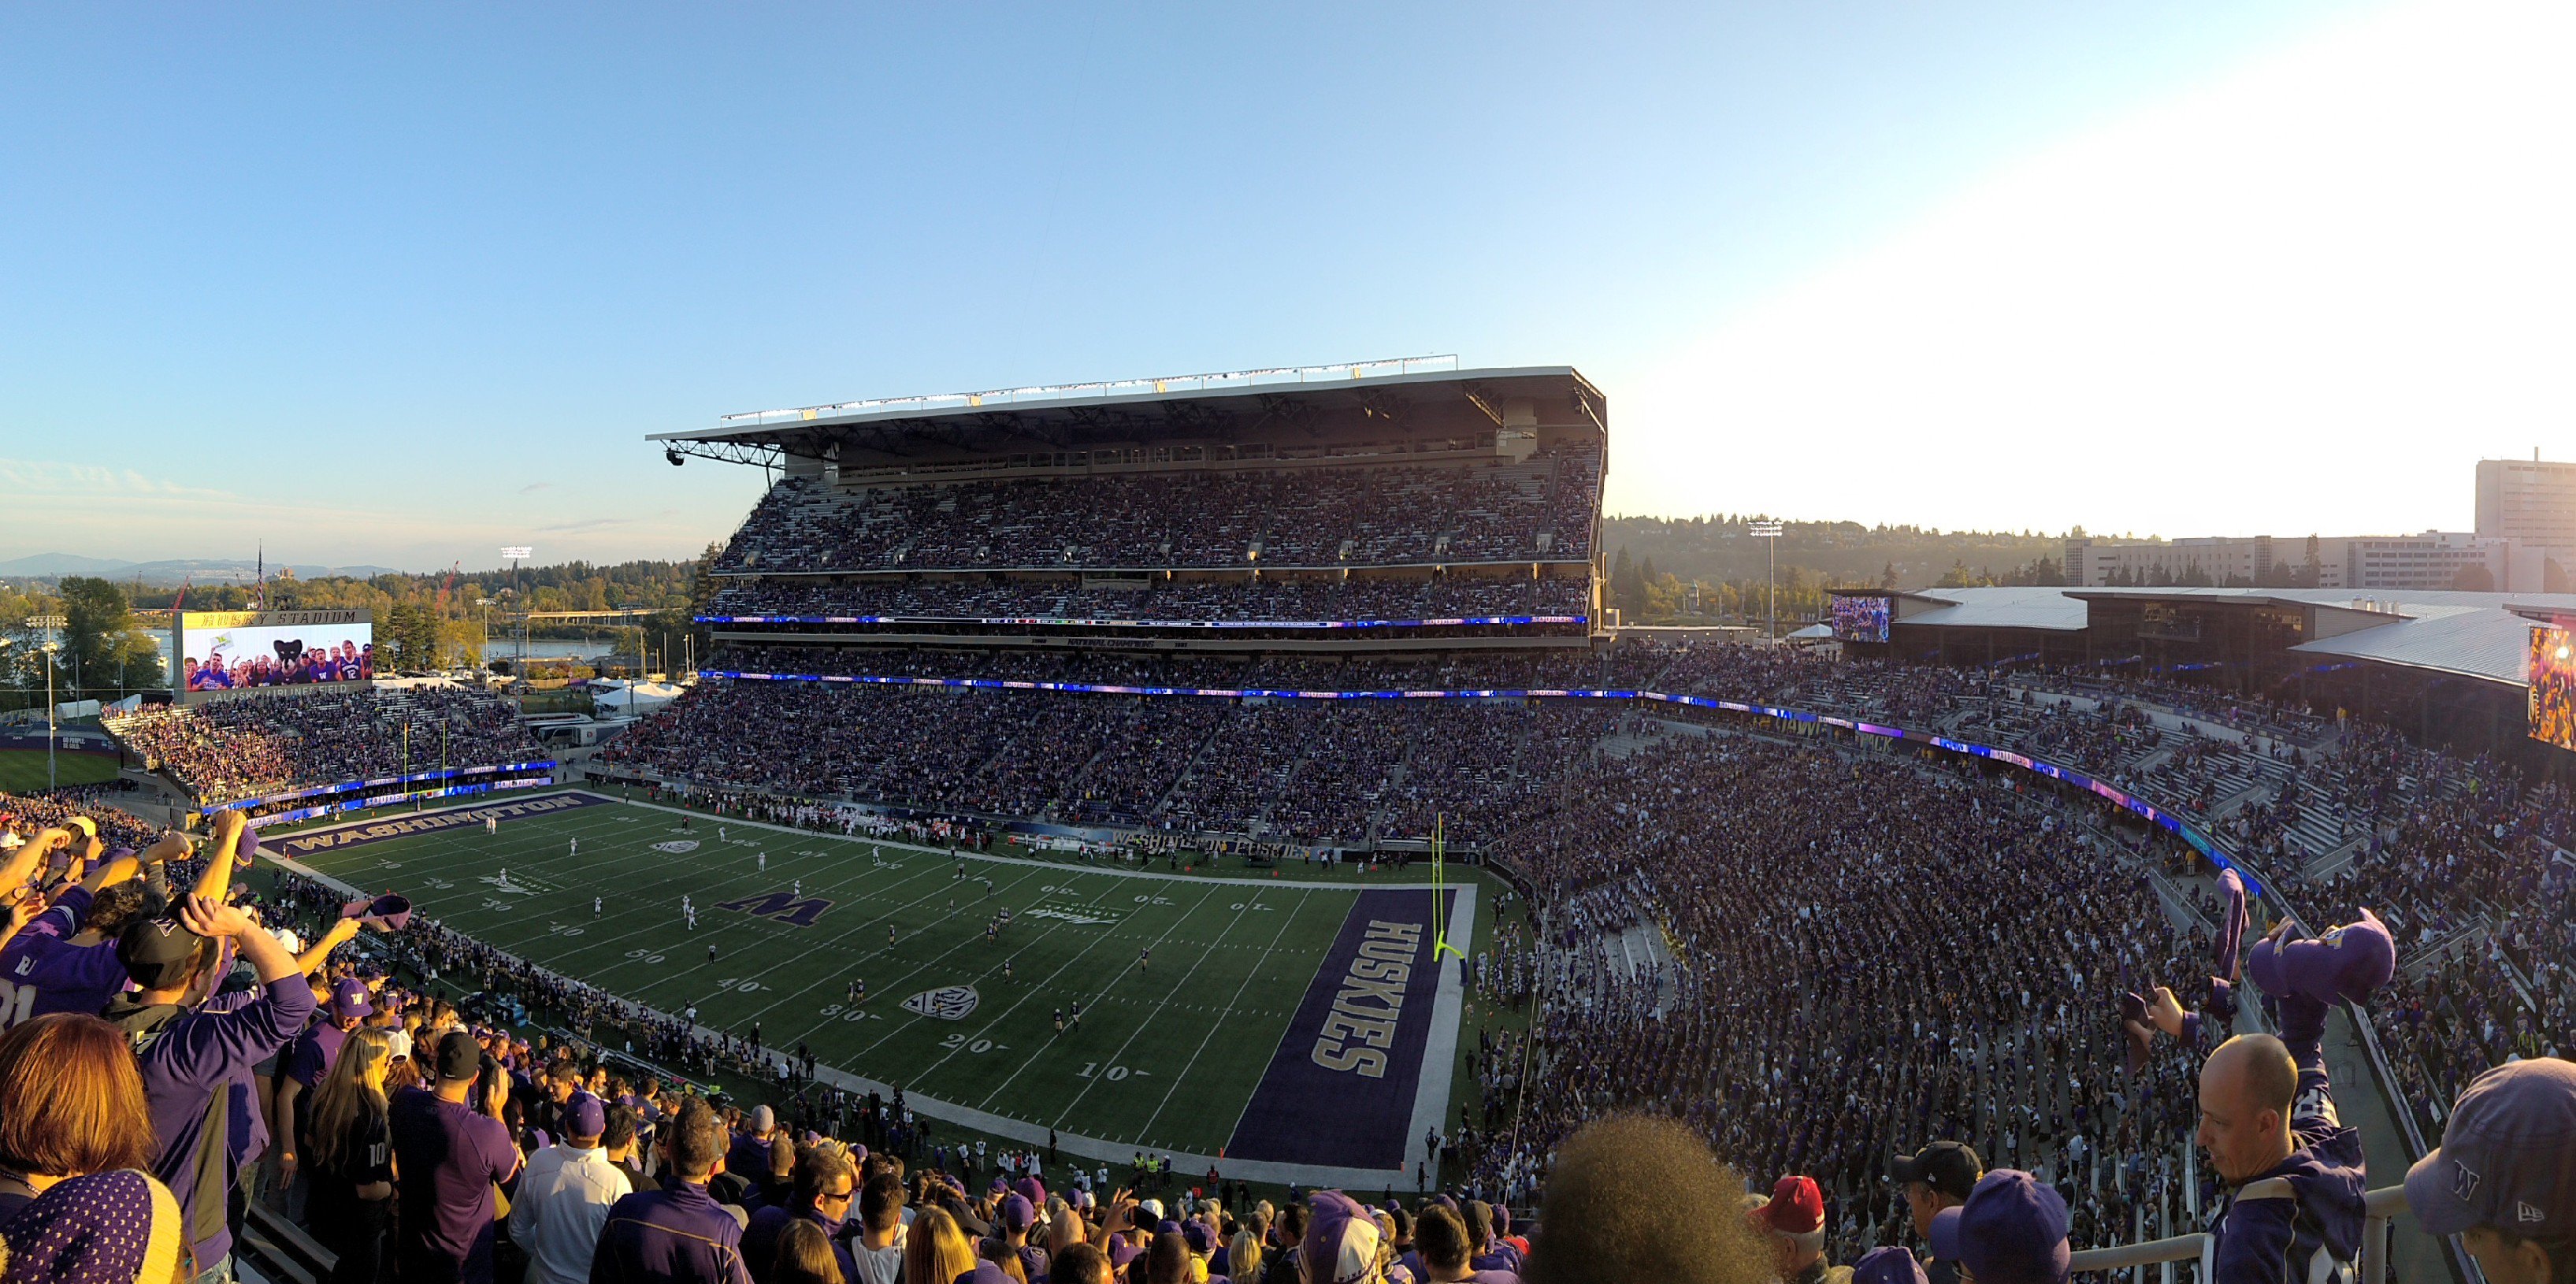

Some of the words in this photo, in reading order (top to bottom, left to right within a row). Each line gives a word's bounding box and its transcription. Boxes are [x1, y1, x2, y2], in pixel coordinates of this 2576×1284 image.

[201, 612, 269, 627] HUSKY
[277, 611, 356, 625] STADIUM
[1107, 640, 1155, 648] CHAMPIONS
[287, 796, 583, 851] WASHINGTON
[713, 892, 836, 927] W
[624, 948, 666, 965] 50
[716, 977, 761, 993] 40
[351, 993, 364, 1005] W
[1311, 919, 1423, 1079] HUSKIES
[819, 1003, 867, 1022] 30
[938, 1033, 993, 1054] 20
[1075, 1061, 1130, 1082] 10
[369, 1141, 386, 1167] 10
